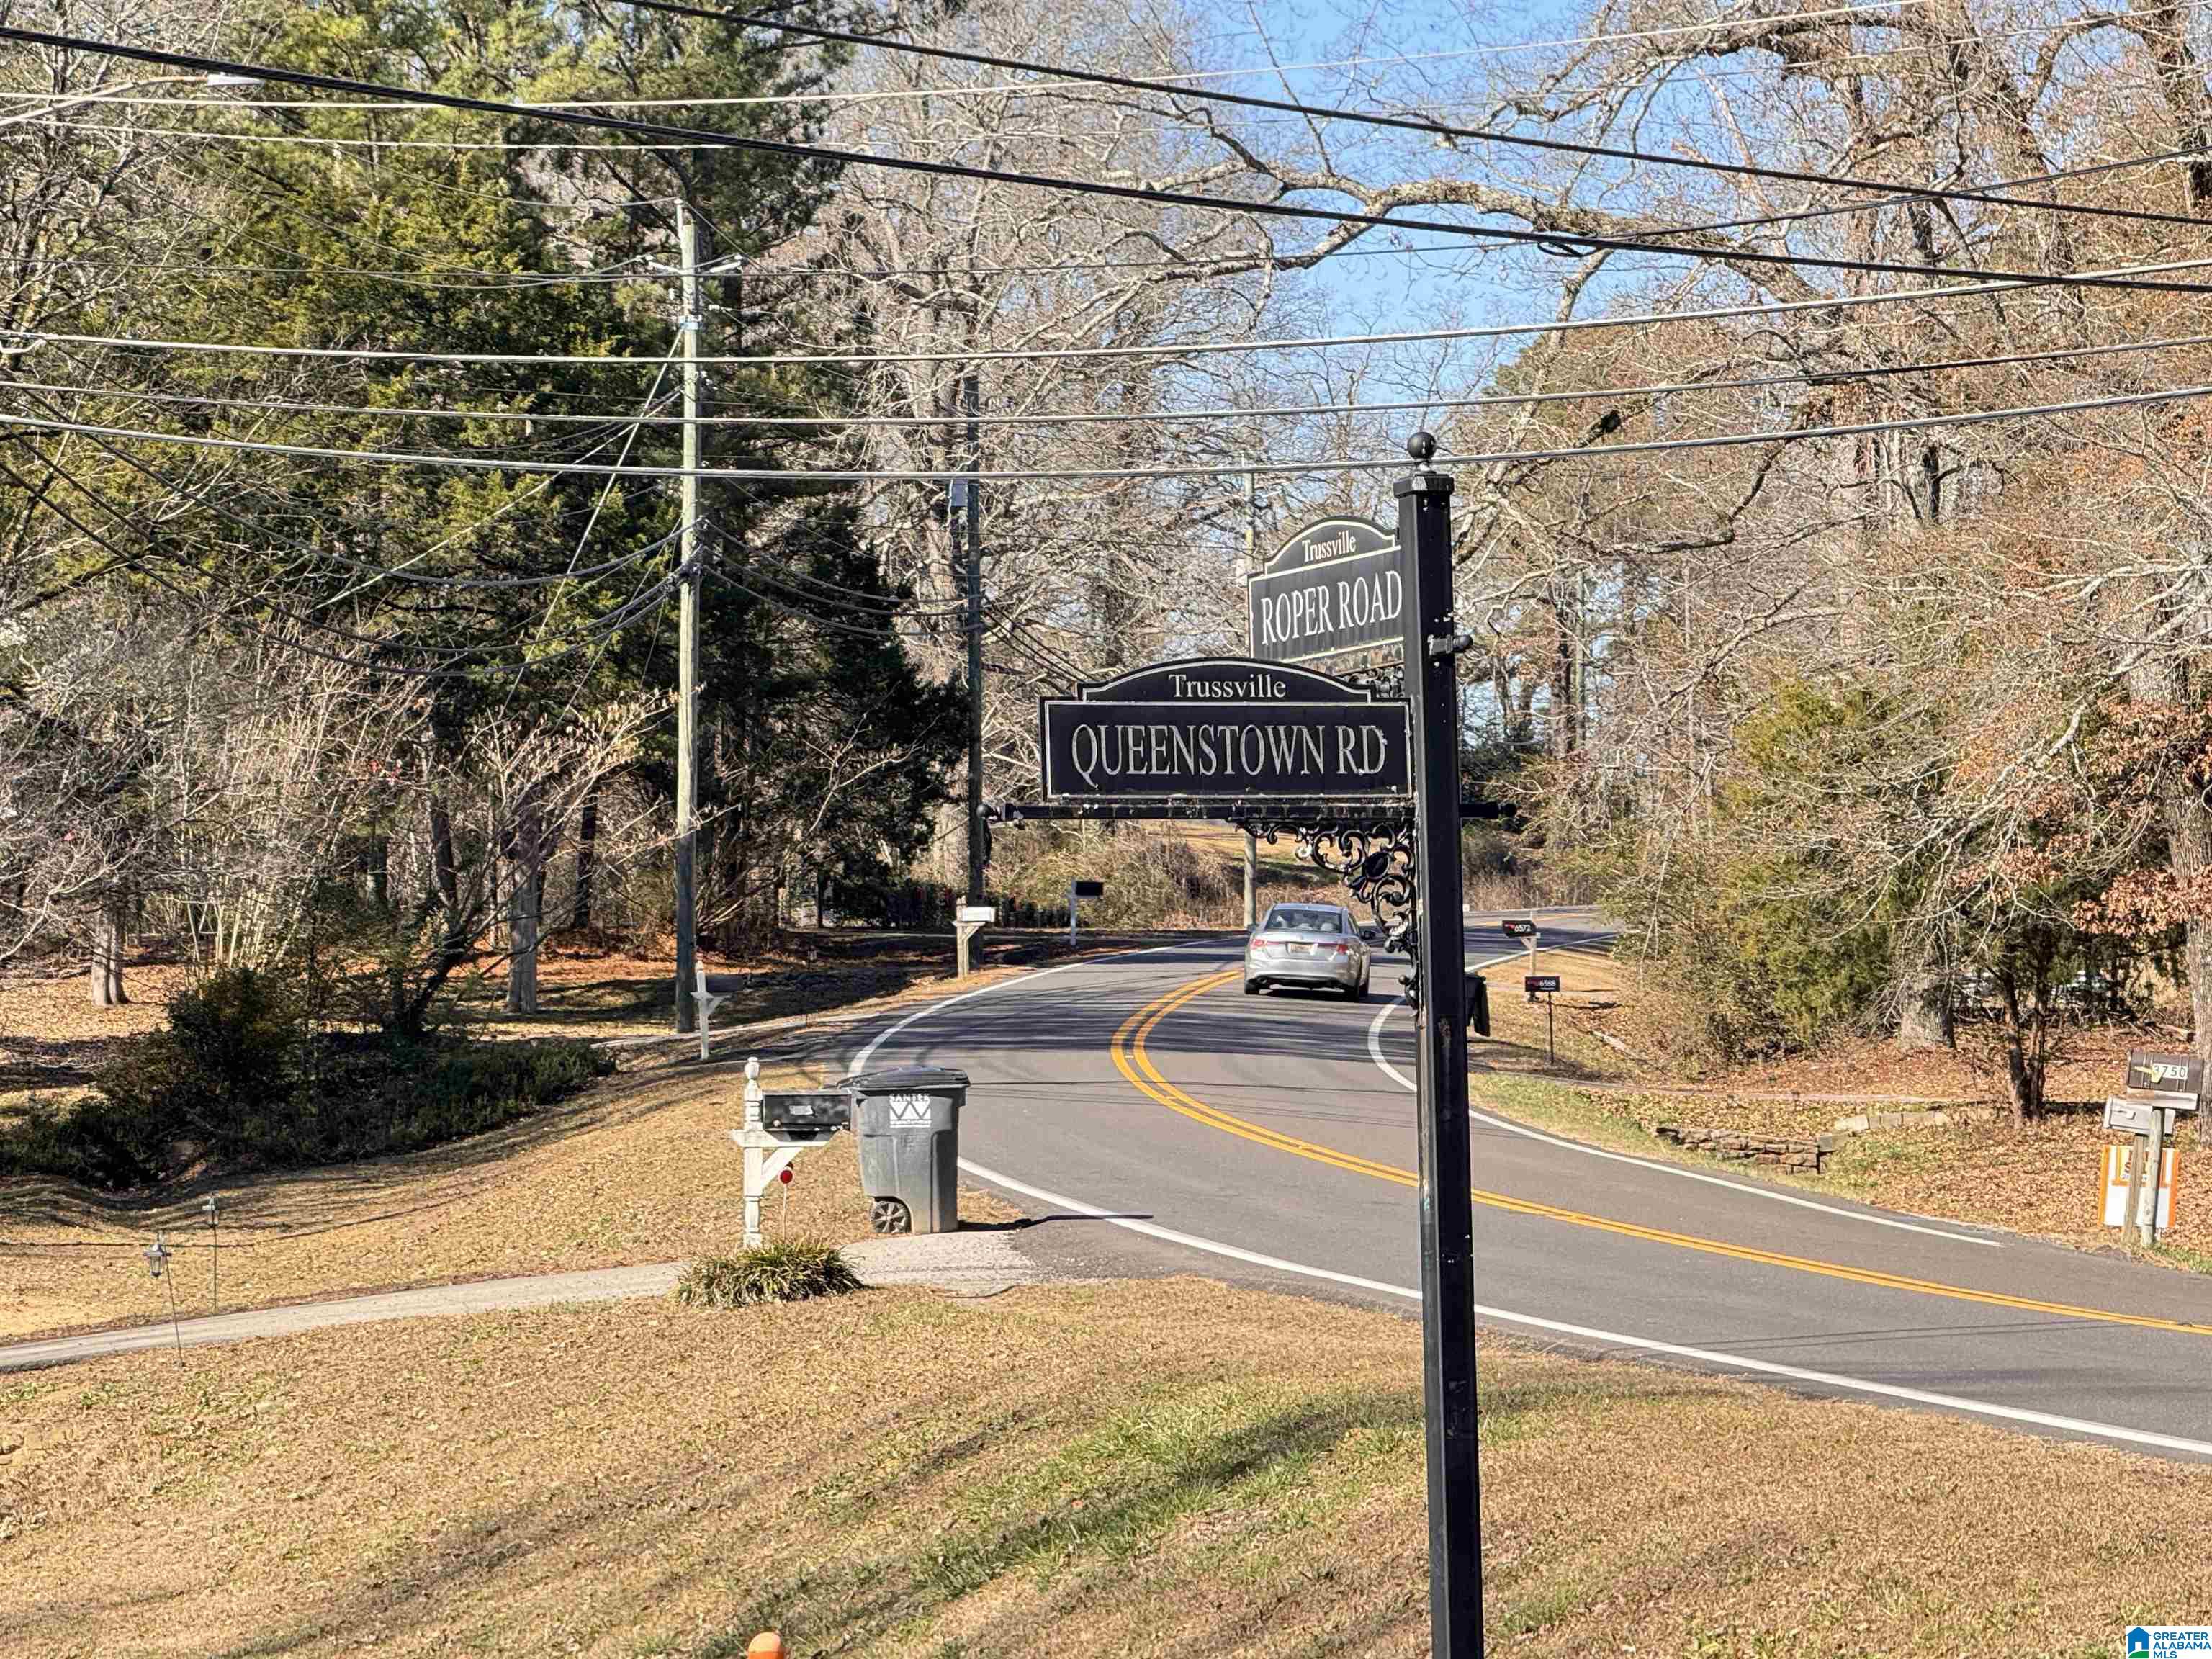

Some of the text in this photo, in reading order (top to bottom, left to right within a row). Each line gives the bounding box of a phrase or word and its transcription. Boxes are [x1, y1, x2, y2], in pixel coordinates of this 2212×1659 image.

[1302, 531, 1358, 564] Trussville
[1261, 570, 1403, 646] ROPER ROAD
[1168, 674, 1287, 699] Trussville
[1071, 724, 1387, 789] QUEENSTOWN RD
